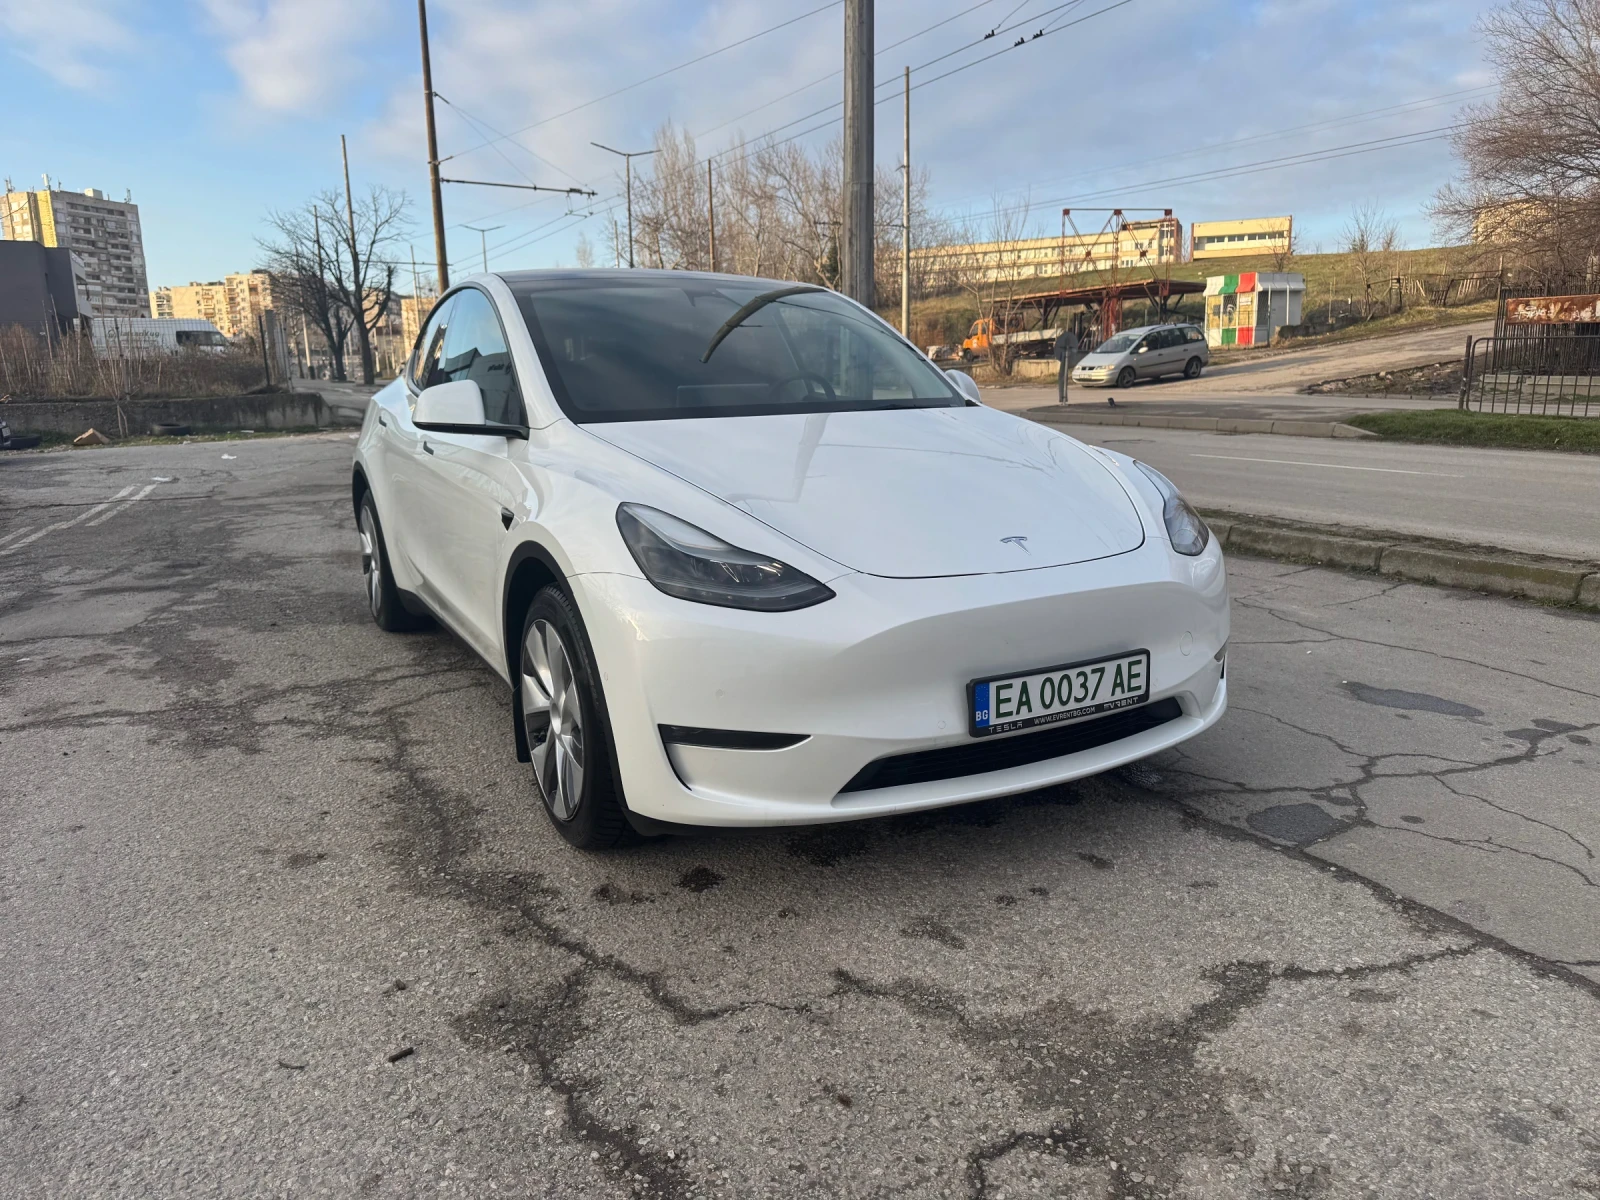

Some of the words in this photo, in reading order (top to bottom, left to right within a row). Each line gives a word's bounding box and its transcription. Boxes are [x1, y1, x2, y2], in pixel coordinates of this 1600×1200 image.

[995, 681, 1033, 719] EA
[1039, 667, 1105, 710] 0037
[1111, 659, 1143, 697] AE
[975, 709, 989, 721] BG
[988, 721, 1023, 734] TESLA
[1033, 706, 1096, 725] WWW.EVRENTBG.COM
[1103, 696, 1139, 710] EVRENT
